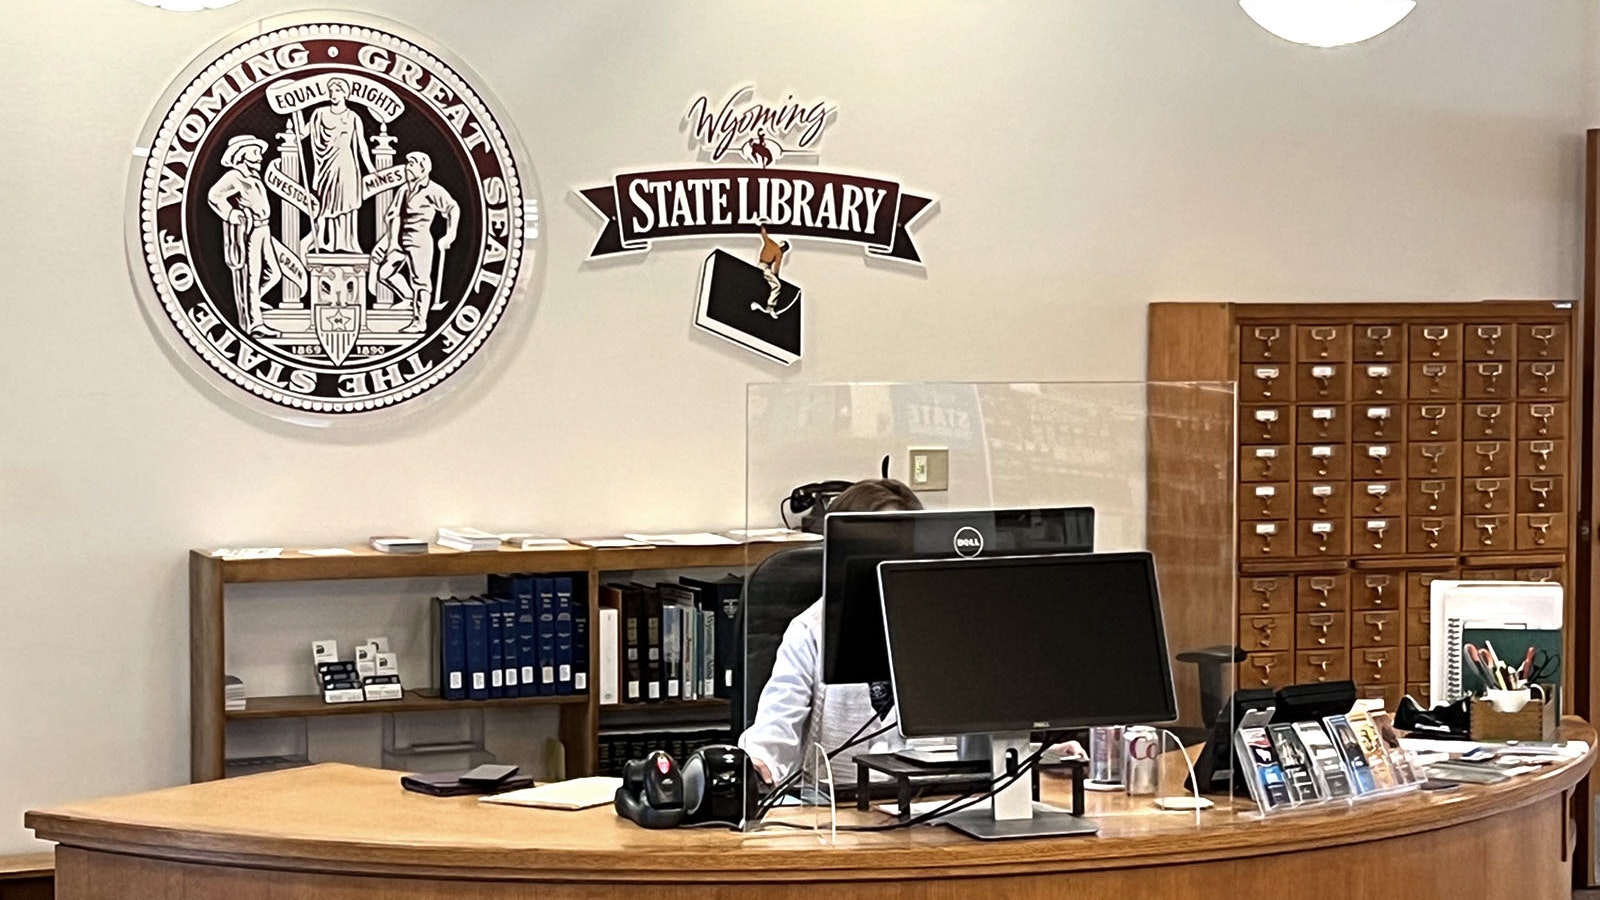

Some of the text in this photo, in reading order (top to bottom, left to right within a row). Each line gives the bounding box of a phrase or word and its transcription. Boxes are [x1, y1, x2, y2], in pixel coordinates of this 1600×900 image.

[275, 81, 402, 117] EQUAL RIGHTS
[688, 85, 837, 160] Wyoming
[365, 170, 402, 191] MINES
[157, 42, 509, 397] GREAT SEAL OF THE STATE OF WYOMING
[628, 177, 887, 235] STATE LIBRARY
[957, 538, 980, 547] DELL
